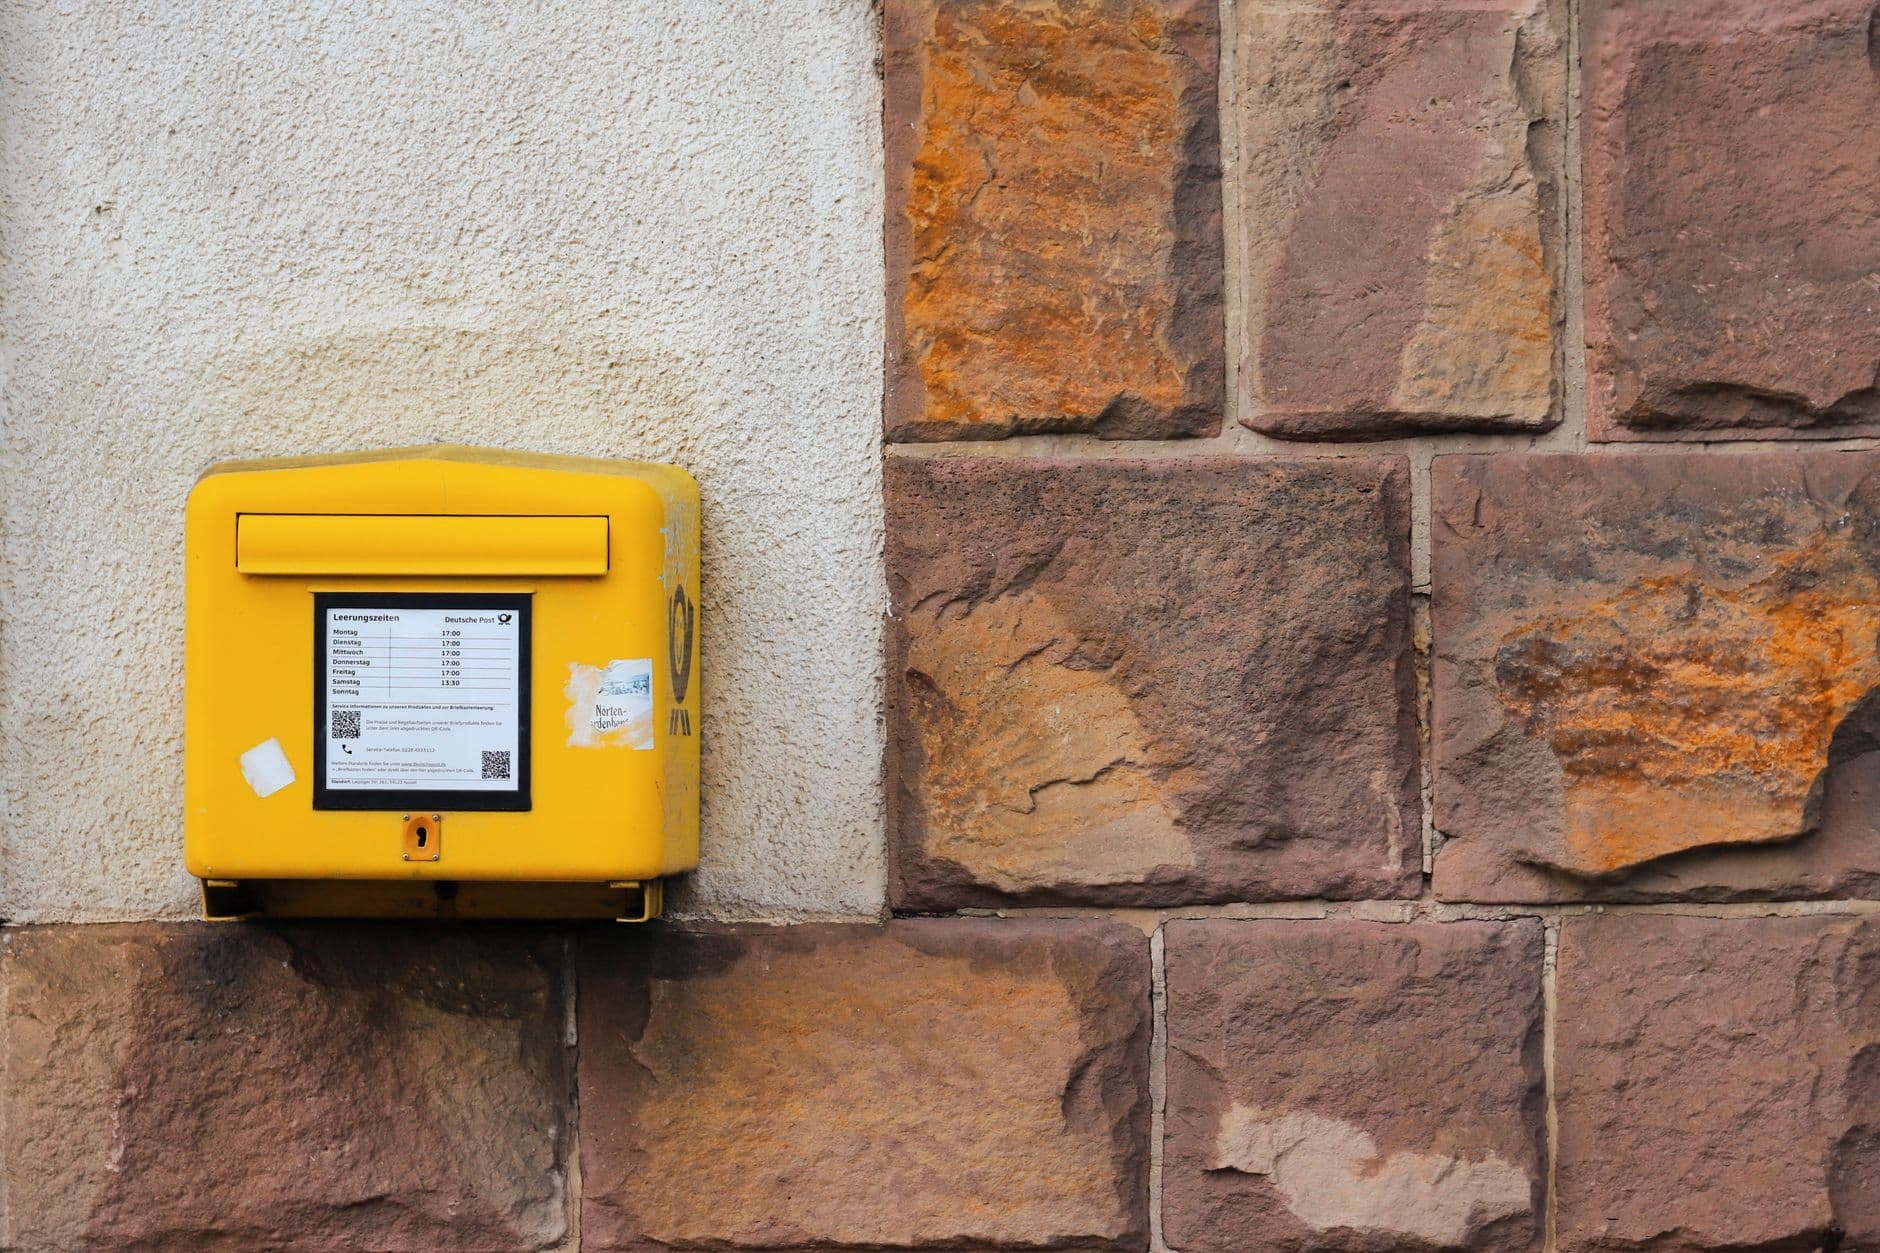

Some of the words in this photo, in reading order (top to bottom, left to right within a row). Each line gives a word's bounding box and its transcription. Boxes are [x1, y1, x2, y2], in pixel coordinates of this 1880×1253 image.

[333, 613, 400, 624] Leerungszeiten
[444, 616, 478, 624] Deutsche
[332, 678, 360, 686] Samstag
[332, 688, 359, 696] Sonntag
[596, 704, 627, 716] Norten-
